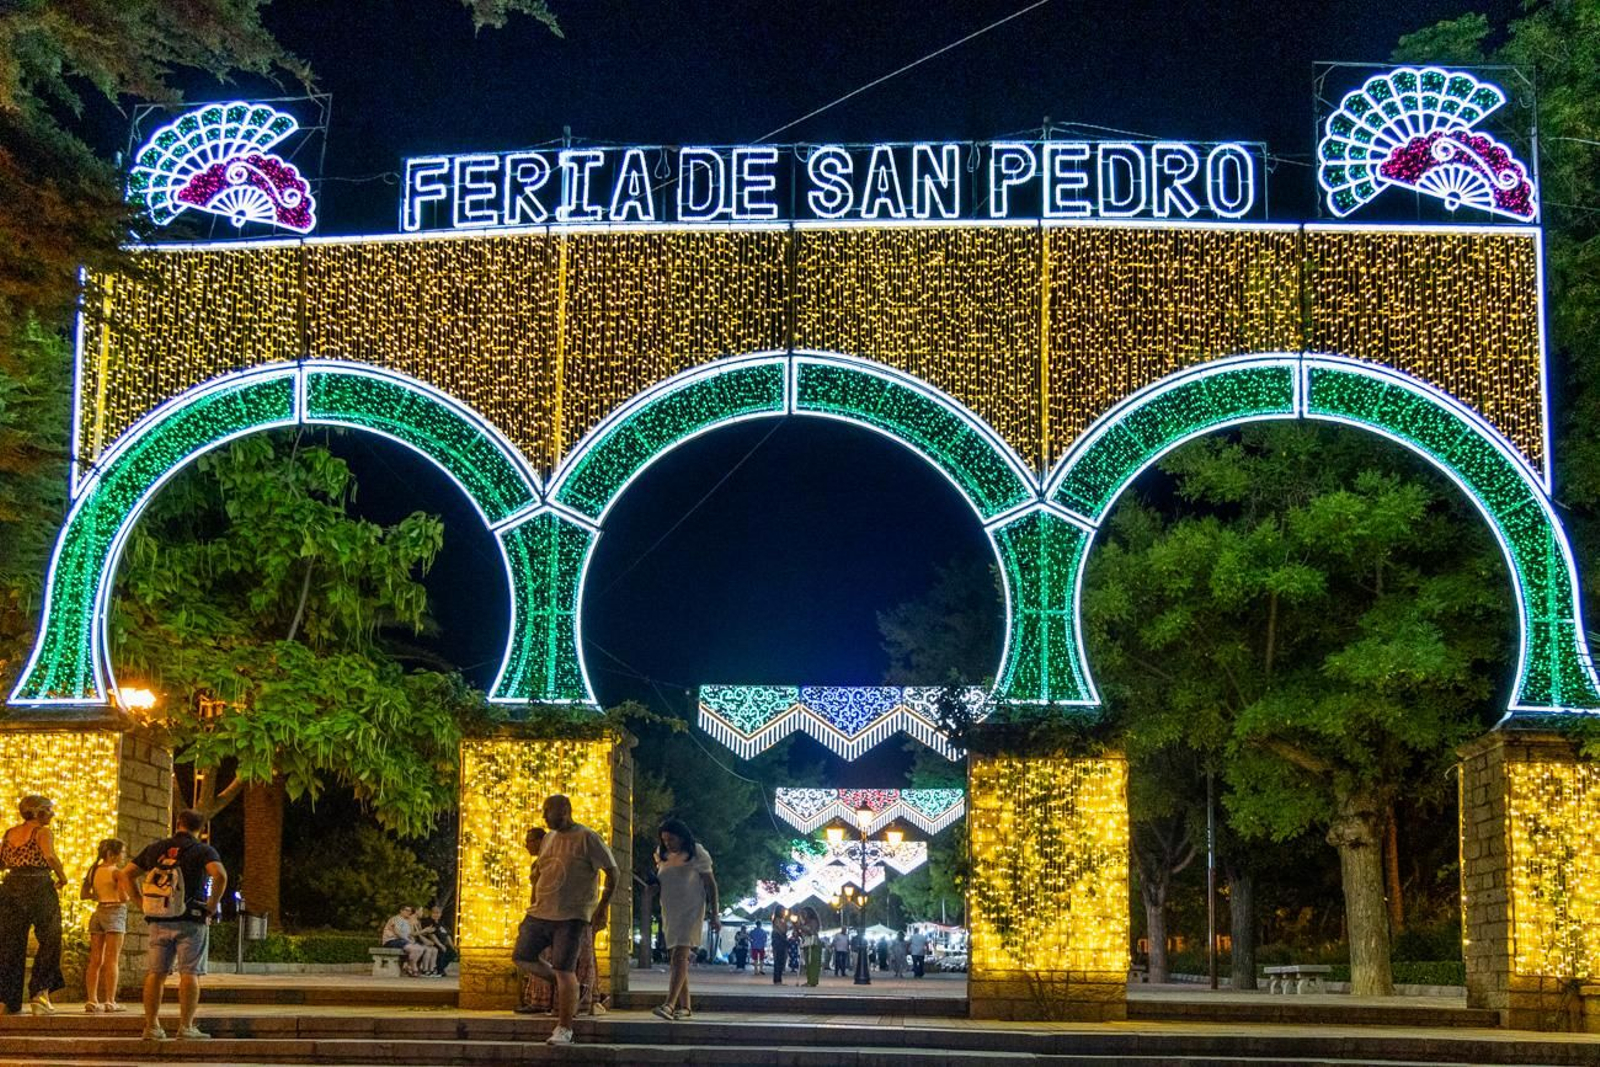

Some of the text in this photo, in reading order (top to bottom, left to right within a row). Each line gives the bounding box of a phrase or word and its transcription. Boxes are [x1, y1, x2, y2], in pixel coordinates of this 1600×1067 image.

[403, 143, 1255, 231] FERIA DE SAN PEDRO
